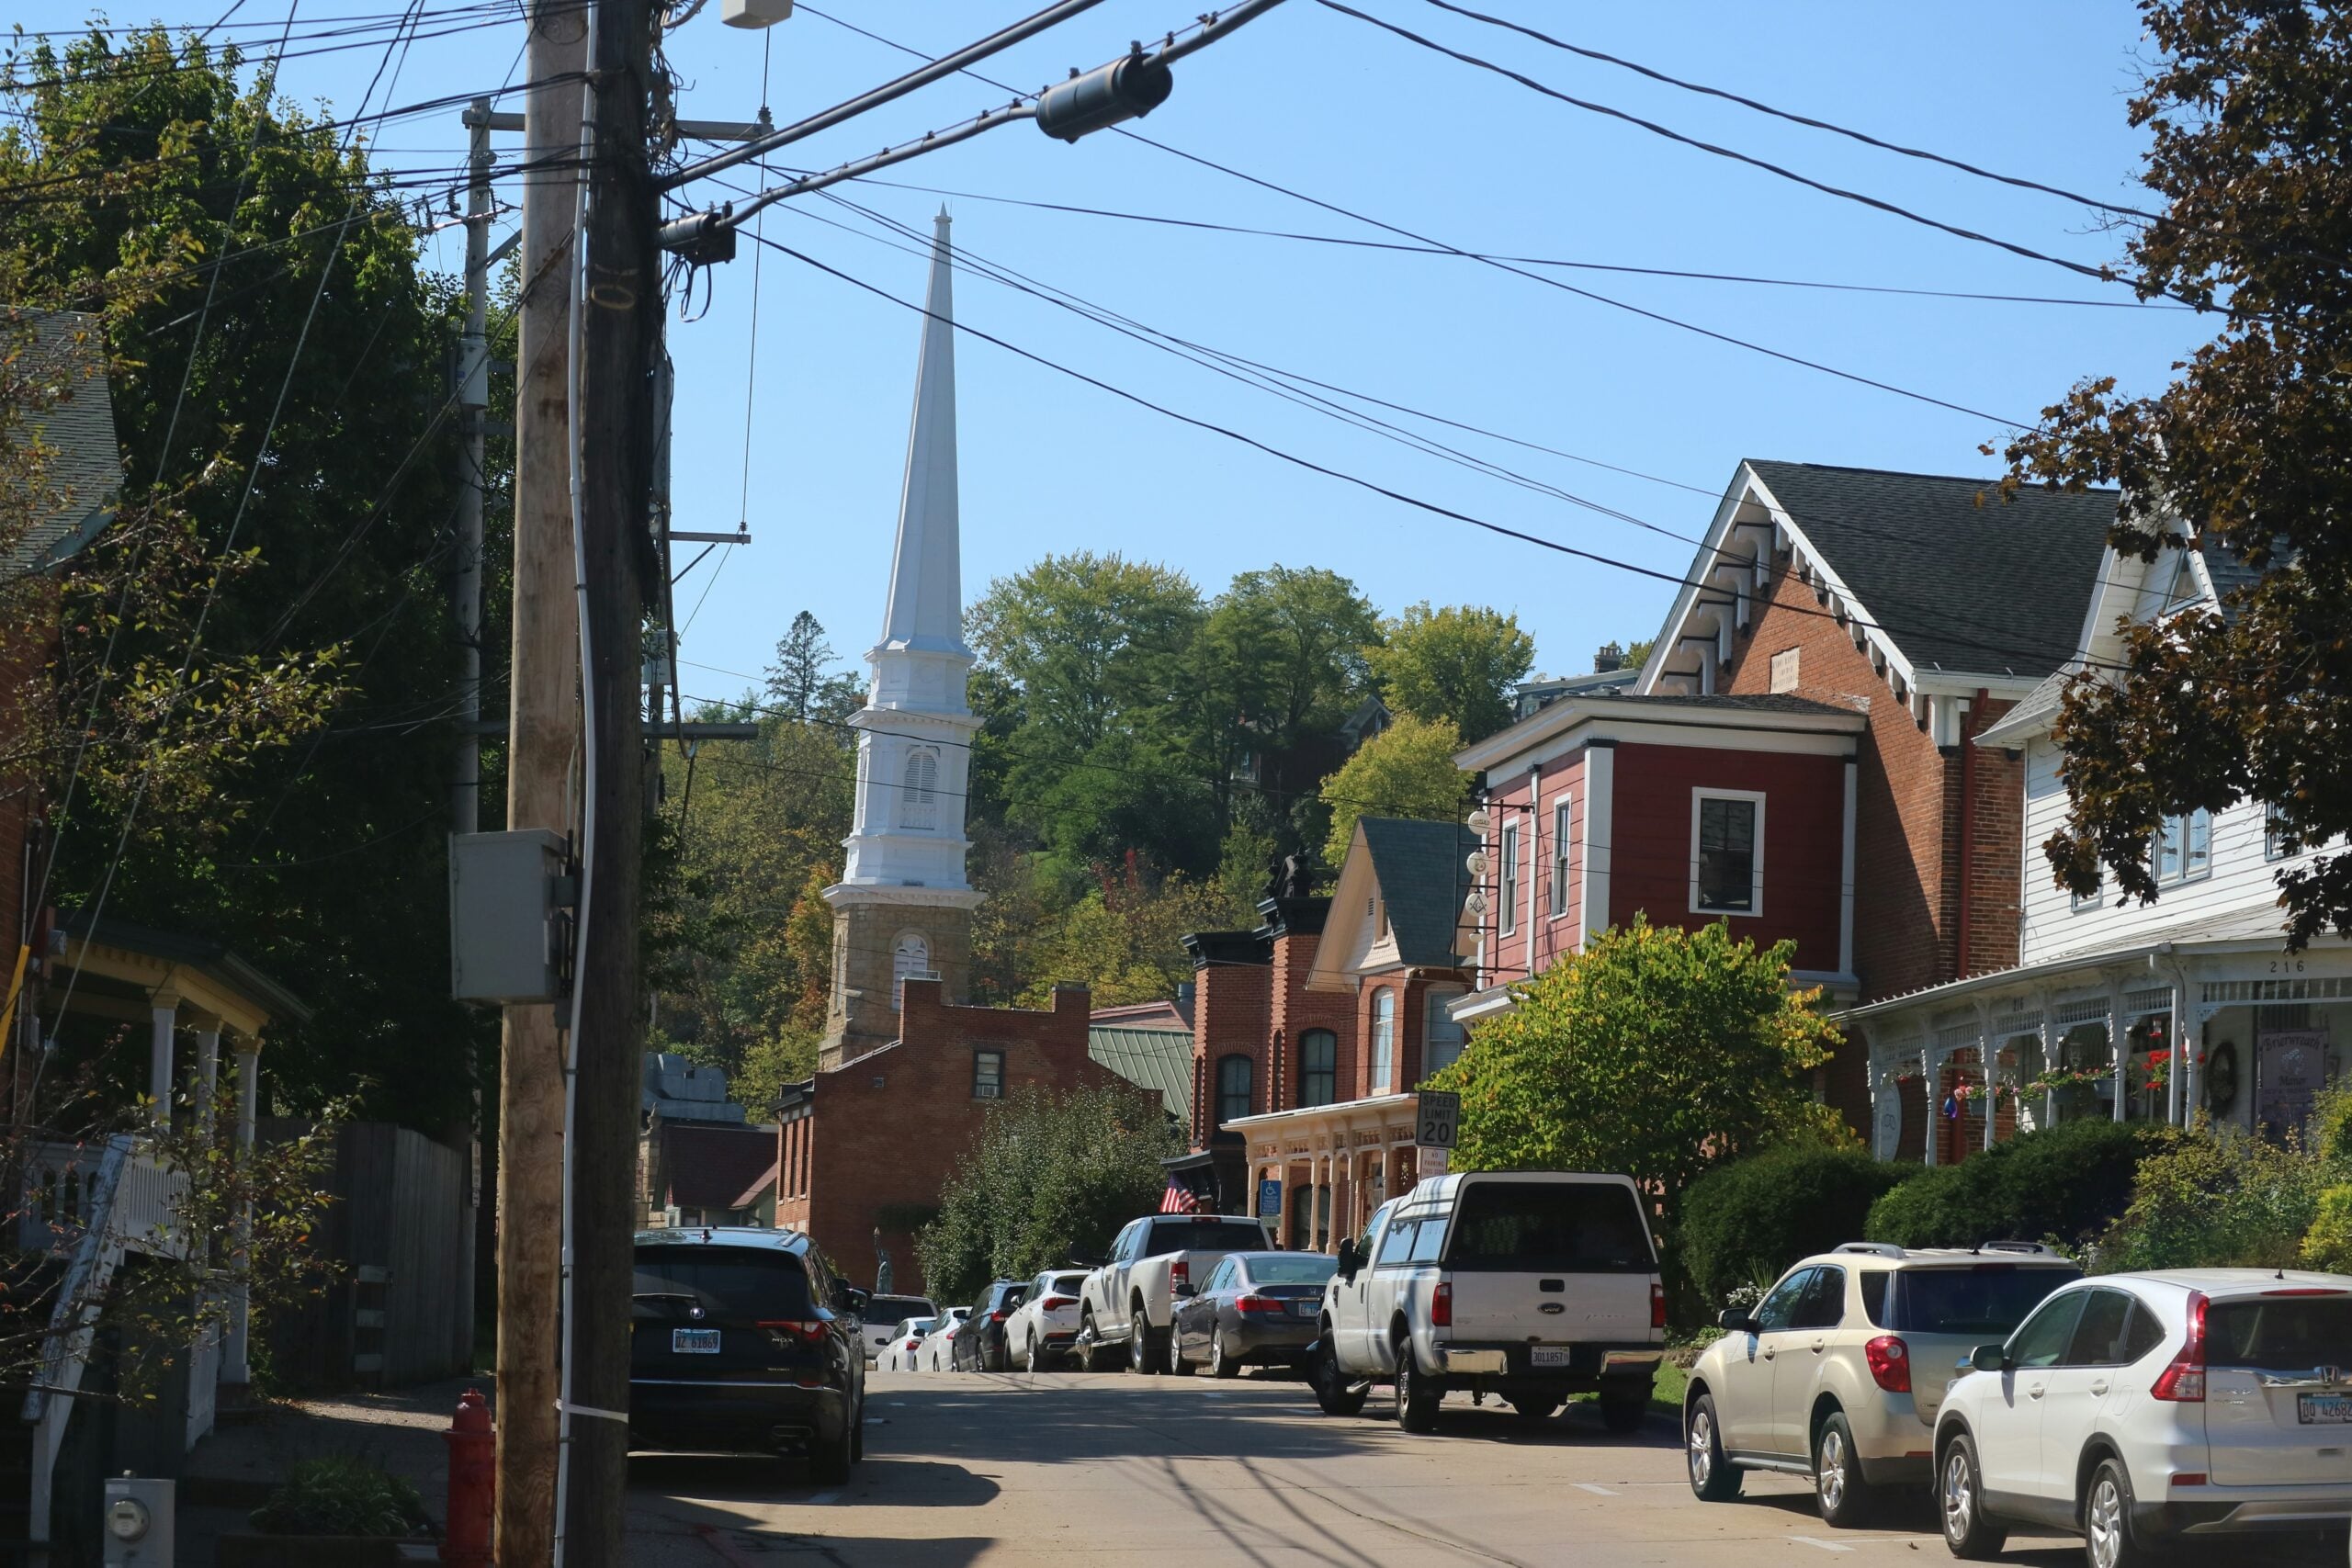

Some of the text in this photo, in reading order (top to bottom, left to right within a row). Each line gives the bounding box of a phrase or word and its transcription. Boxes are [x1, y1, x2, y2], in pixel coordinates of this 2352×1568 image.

[2270, 960, 2304, 973] 216
[1423, 1094, 1455, 1108] SPEED
[1425, 1108, 1452, 1120] LIMIT
[1424, 1122, 1450, 1143] 20
[691, 1337, 718, 1348] 61869
